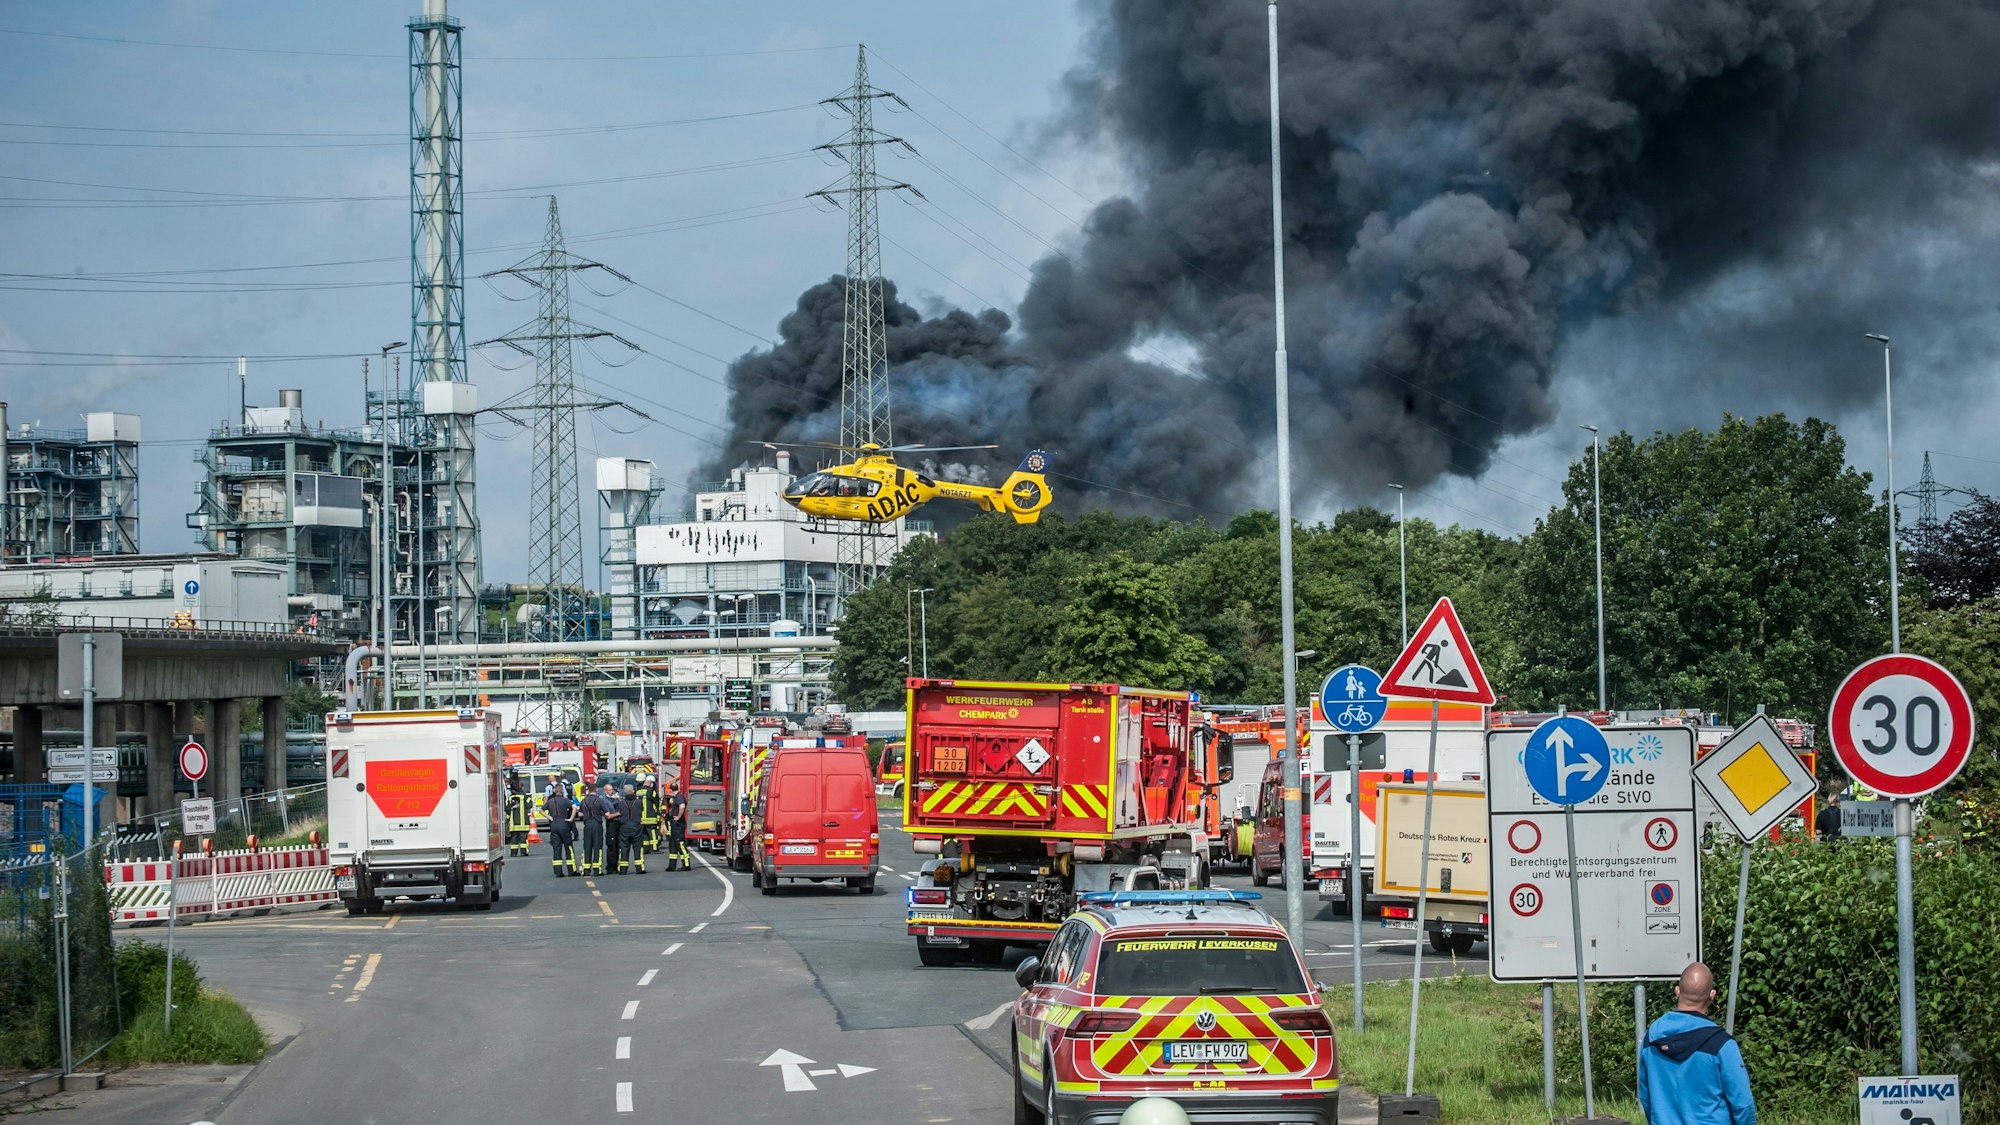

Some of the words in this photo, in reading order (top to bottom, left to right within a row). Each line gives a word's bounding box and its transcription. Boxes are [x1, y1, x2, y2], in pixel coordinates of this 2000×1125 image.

[940, 488, 972, 498] NOTARZT
[867, 483, 920, 521] ADAC
[946, 695, 1033, 706] WERKFEUERWEHR
[959, 709, 1008, 720] CHEMPARK
[1861, 695, 1940, 756] 30
[944, 748, 957, 758] 30
[937, 761, 964, 771] 1202
[1617, 790, 1651, 804] StVO
[407, 801, 420, 809] 112
[1398, 831, 1436, 841] Deutsces
[1438, 834, 1459, 842] Rotes
[1460, 835, 1481, 844] Kreuz
[1510, 857, 1568, 868] Berechtigte
[1574, 856, 1677, 868] Entsorgungszentrum
[1532, 870, 1550, 879] und
[1555, 868, 1635, 880] Wuperverband
[1639, 868, 1656, 877] frei
[1516, 892, 1536, 908] 30
[1117, 940, 1197, 953] FEUERWEHR
[1198, 940, 1278, 952] LEVERKUSEN
[1172, 1044, 1196, 1058] LEV
[1205, 1044, 1220, 1058] FW
[1223, 1044, 1246, 1058] 907
[1861, 1080, 1955, 1101] MAINKA
